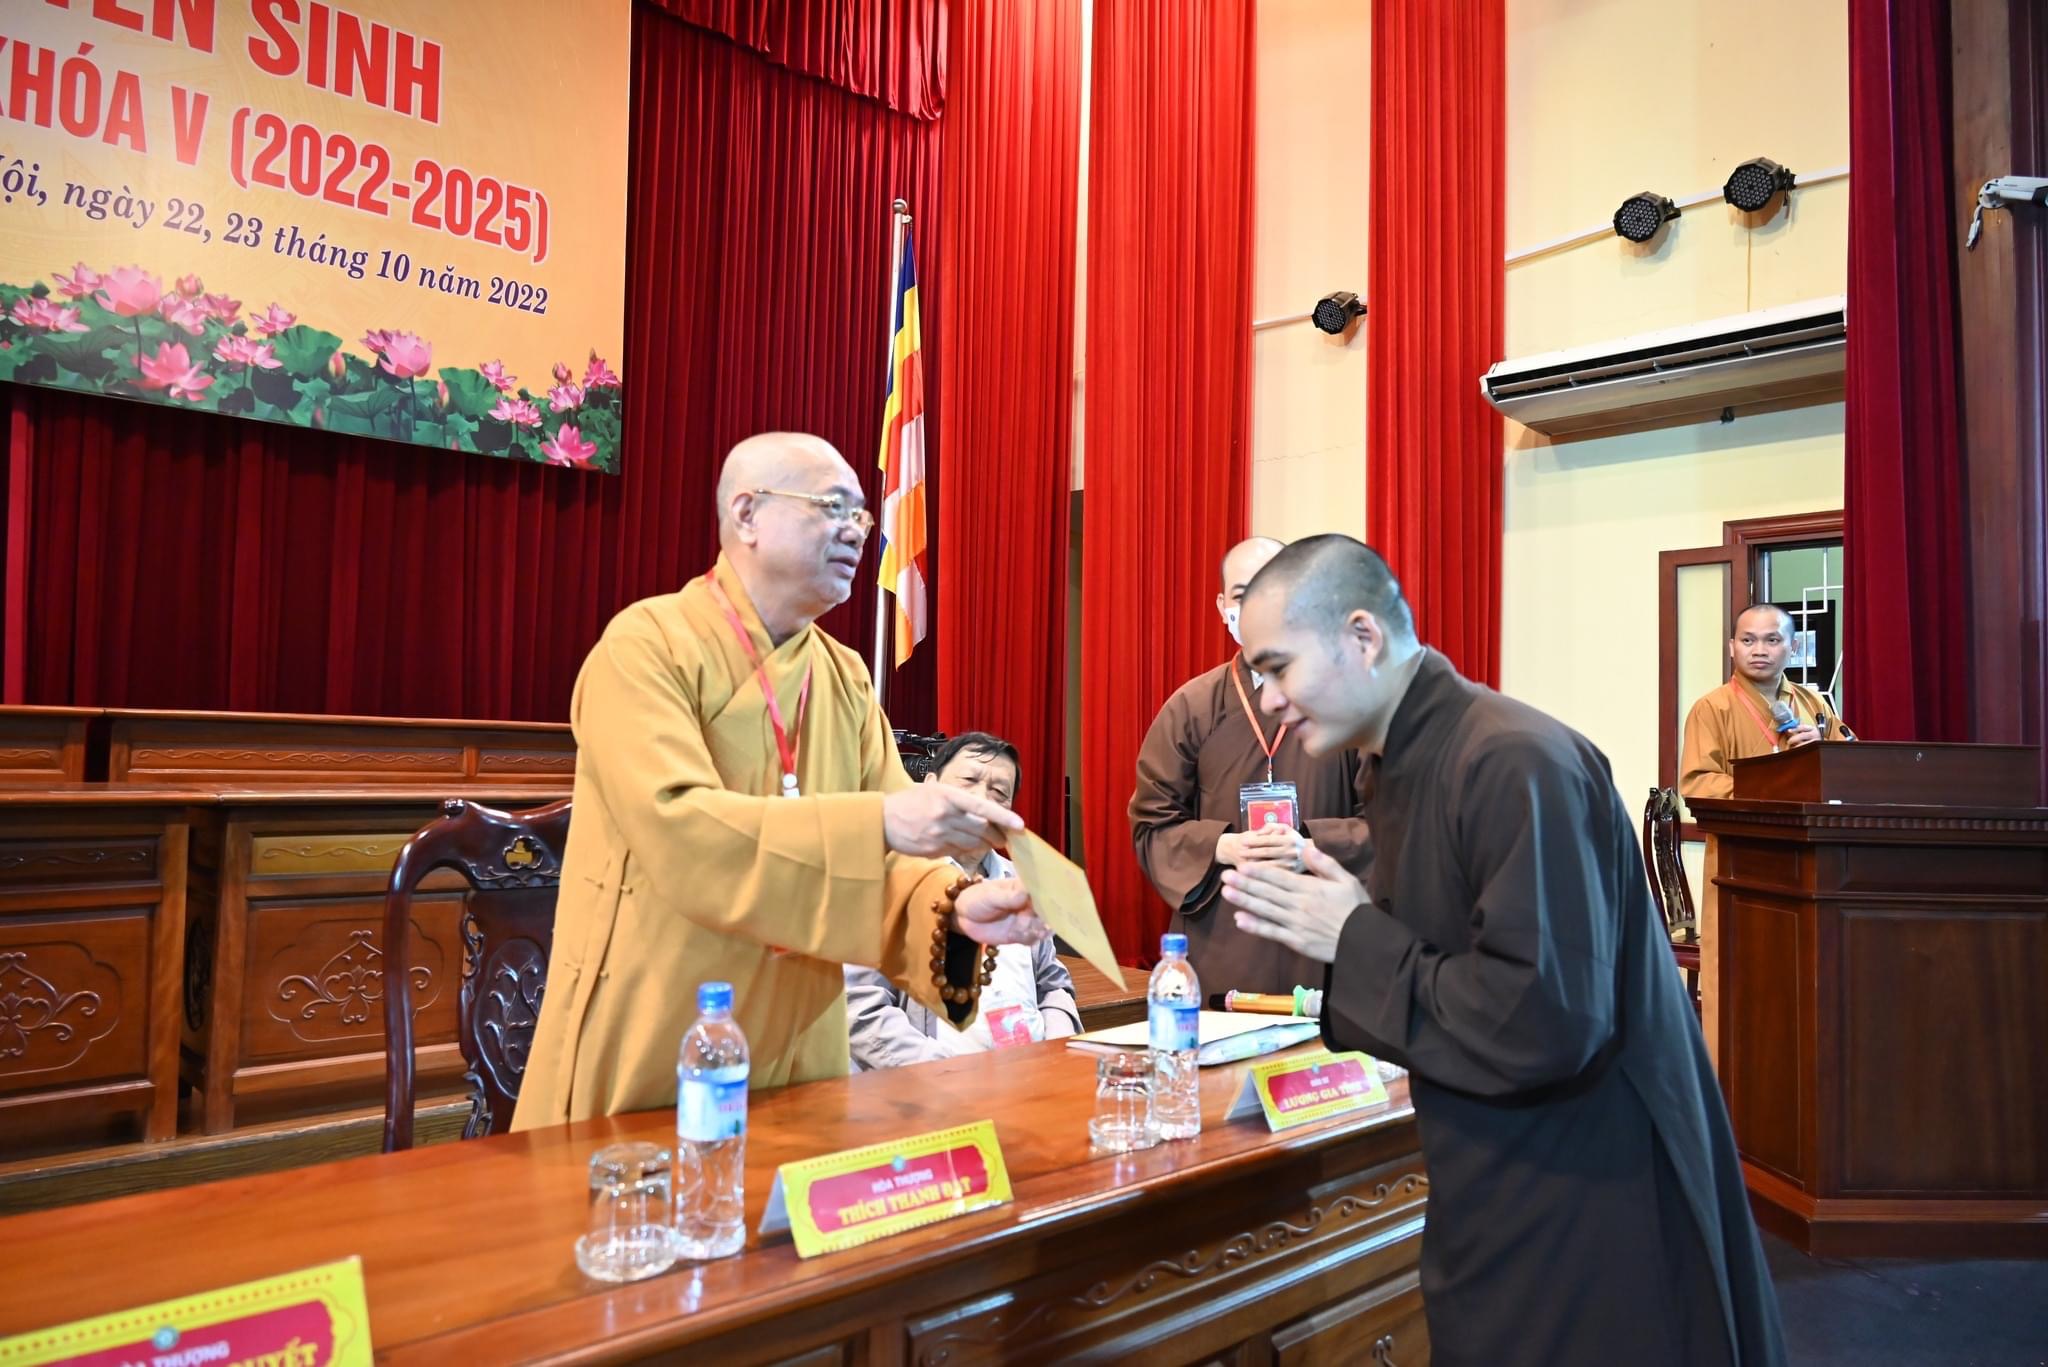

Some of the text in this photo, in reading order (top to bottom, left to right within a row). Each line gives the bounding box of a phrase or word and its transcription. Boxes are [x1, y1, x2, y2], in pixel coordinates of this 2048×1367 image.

[248, 0, 441, 124] SINH
[0, 35, 549, 263] HÓA V (2022-2025)
[0, 156, 549, 315] ội, ngày 22, 23 tháng 10 năm 2022
